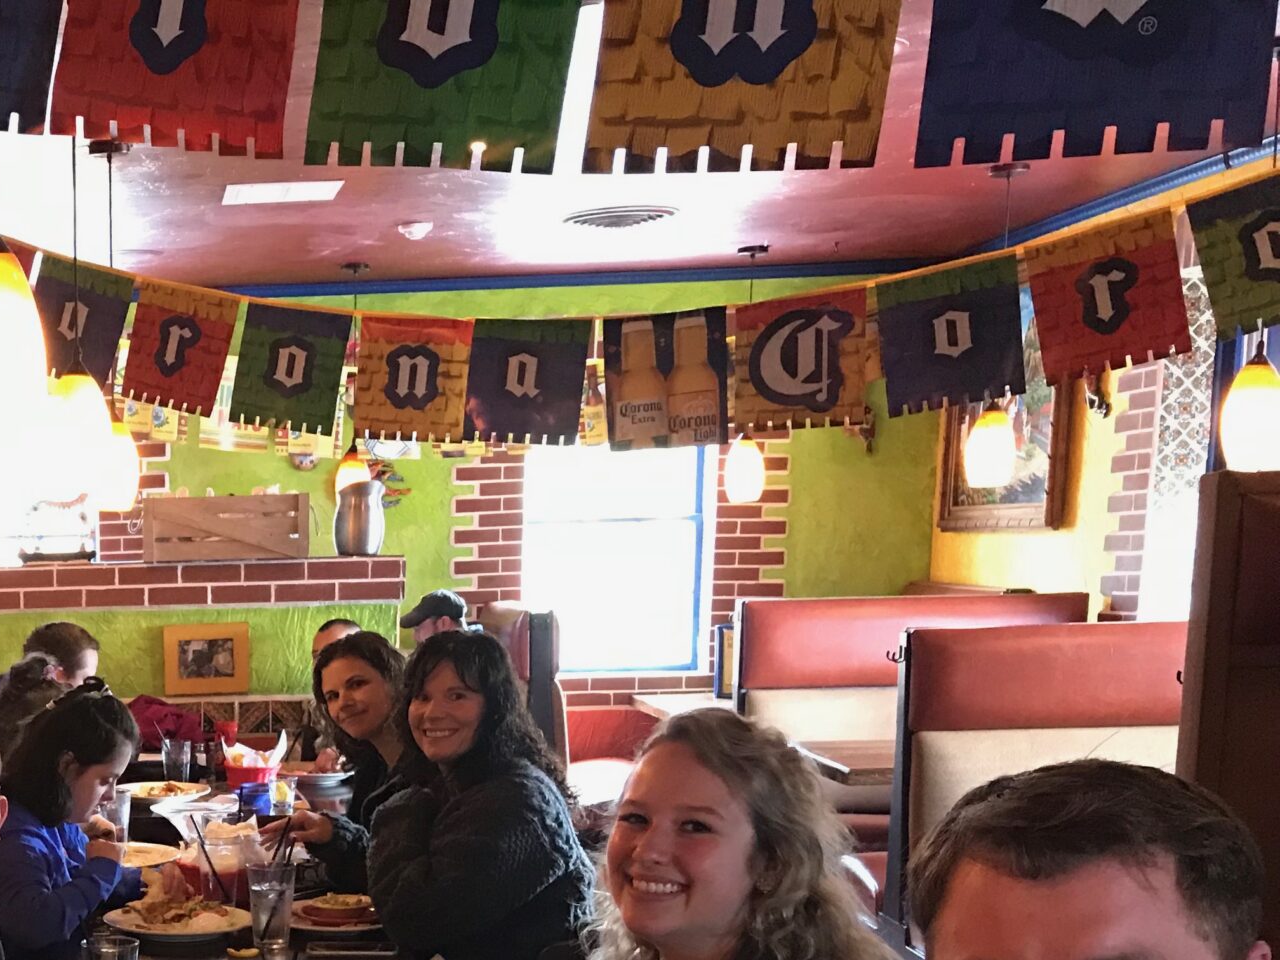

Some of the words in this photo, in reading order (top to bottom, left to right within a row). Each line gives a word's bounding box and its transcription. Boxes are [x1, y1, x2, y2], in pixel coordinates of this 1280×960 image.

[620, 401, 663, 417] Corona
[631, 415, 656, 424] Extra
[669, 414, 717, 433] Corona
